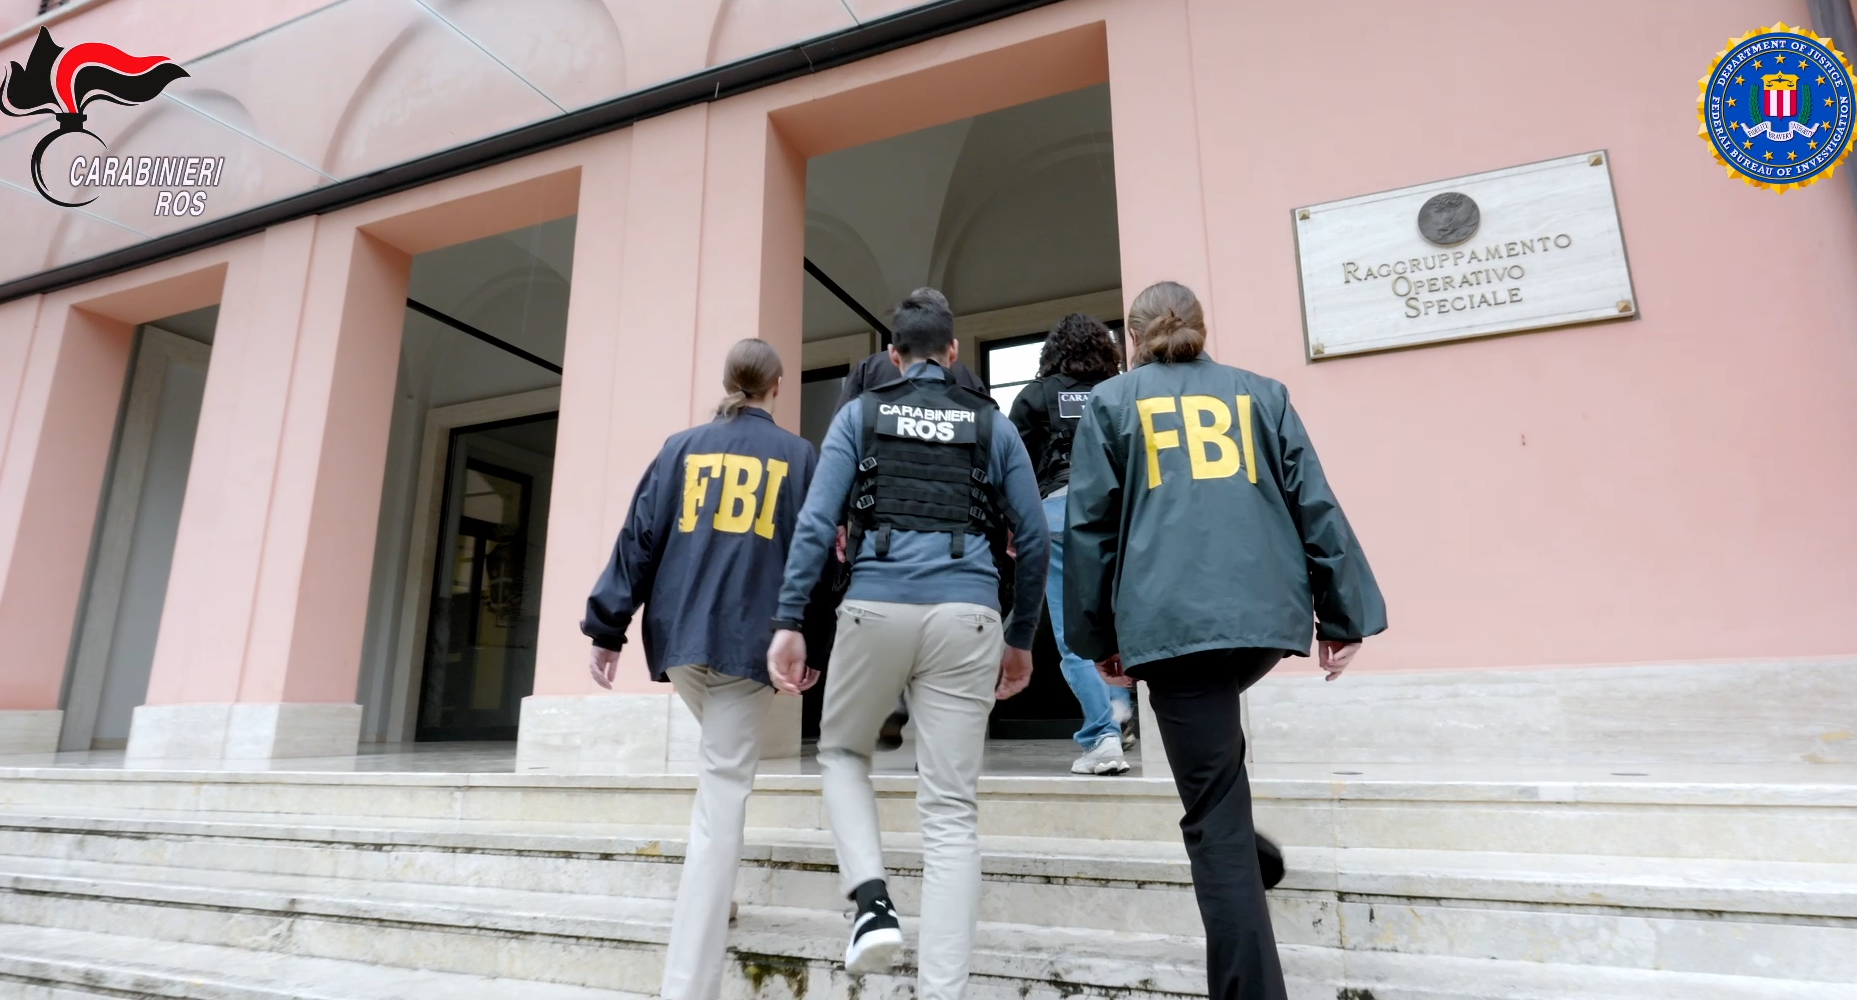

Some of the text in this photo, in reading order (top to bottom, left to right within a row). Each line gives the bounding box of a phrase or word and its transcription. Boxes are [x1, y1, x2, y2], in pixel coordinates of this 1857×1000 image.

[1341, 232, 1573, 285] RAGGRUPPAMENTO
[1391, 264, 1526, 298] OPERATIVO
[1404, 287, 1524, 319] SPECIALE
[878, 402, 976, 424] CARABINIERI
[1060, 394, 1089, 402] CARA
[895, 416, 956, 442] ROS
[1135, 394, 1258, 490] FBI
[677, 452, 789, 540] FBI
